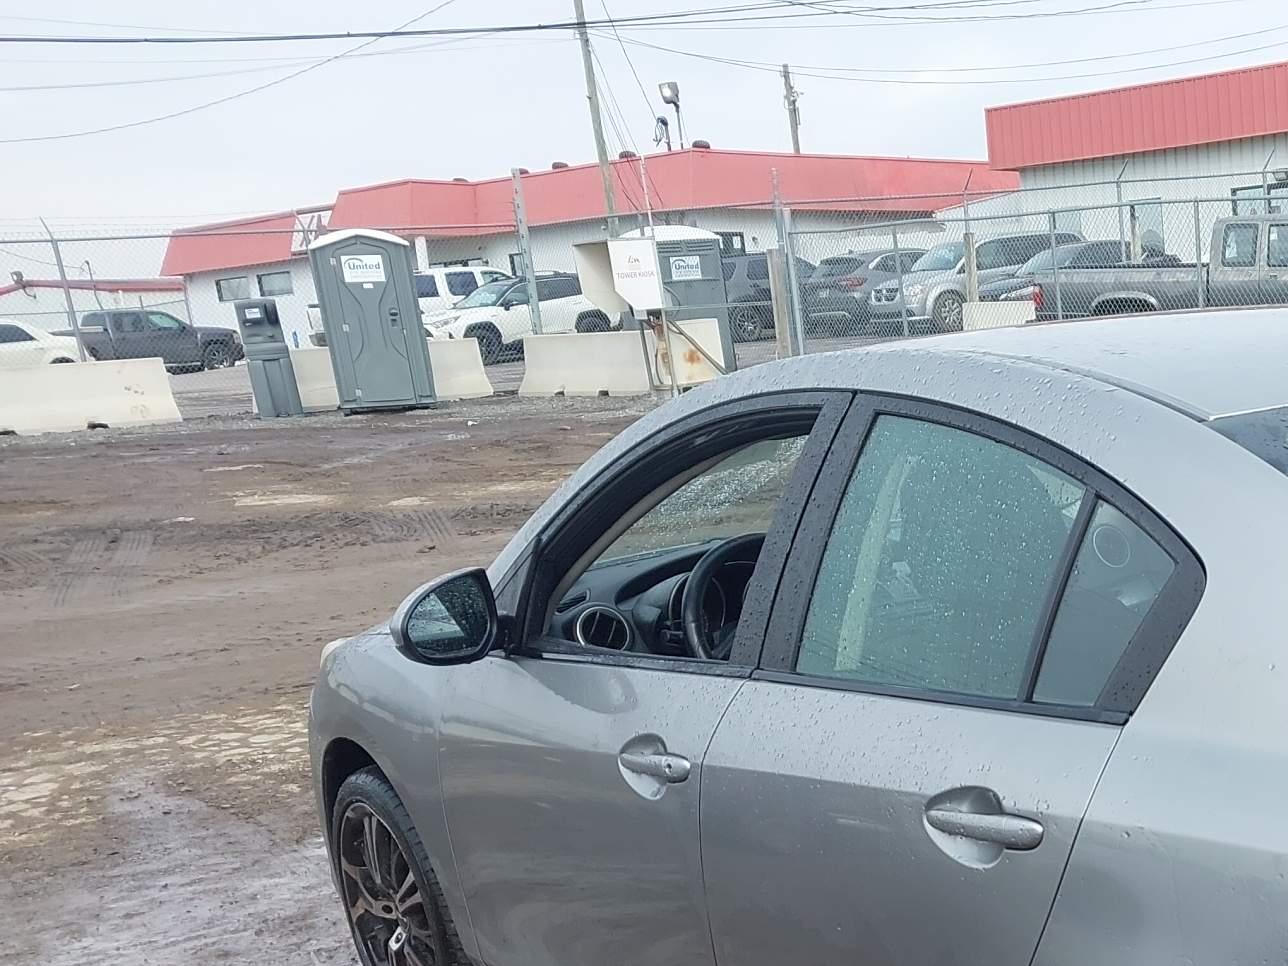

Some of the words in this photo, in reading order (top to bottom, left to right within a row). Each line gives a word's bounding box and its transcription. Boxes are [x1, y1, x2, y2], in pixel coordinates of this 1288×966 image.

[347, 261, 381, 270] United
[674, 261, 700, 271] United
[616, 271, 638, 279] TOWER
